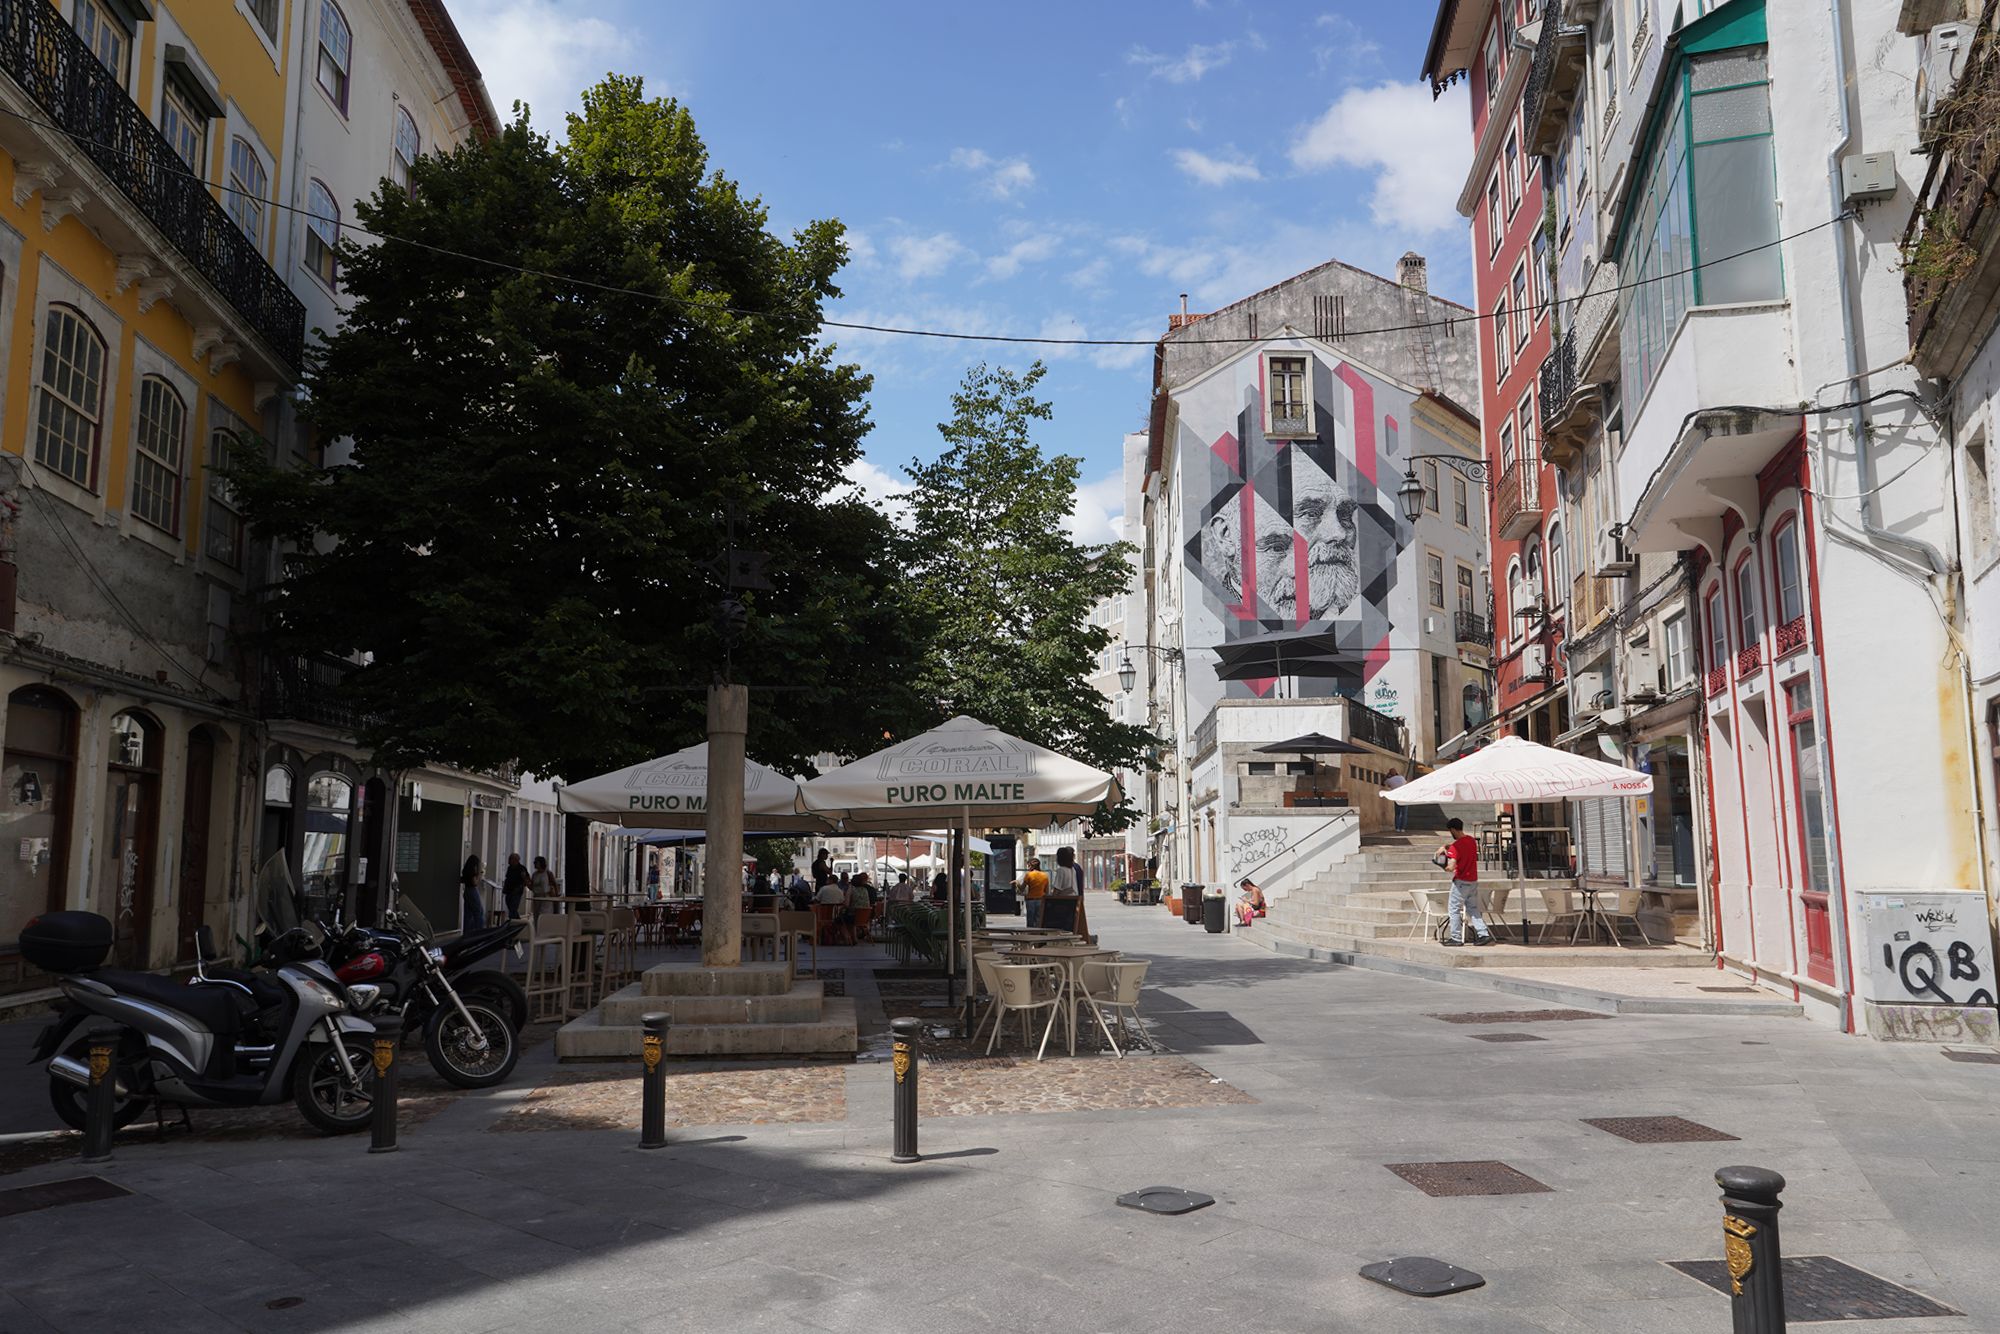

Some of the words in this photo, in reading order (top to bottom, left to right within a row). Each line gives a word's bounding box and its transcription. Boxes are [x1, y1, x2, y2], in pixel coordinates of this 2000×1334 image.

[900, 756, 1019, 775] CORAL
[645, 771, 707, 787] COR
[886, 784, 947, 804] PURO
[954, 783, 1025, 801] MALTE
[629, 795, 680, 810] PURO
